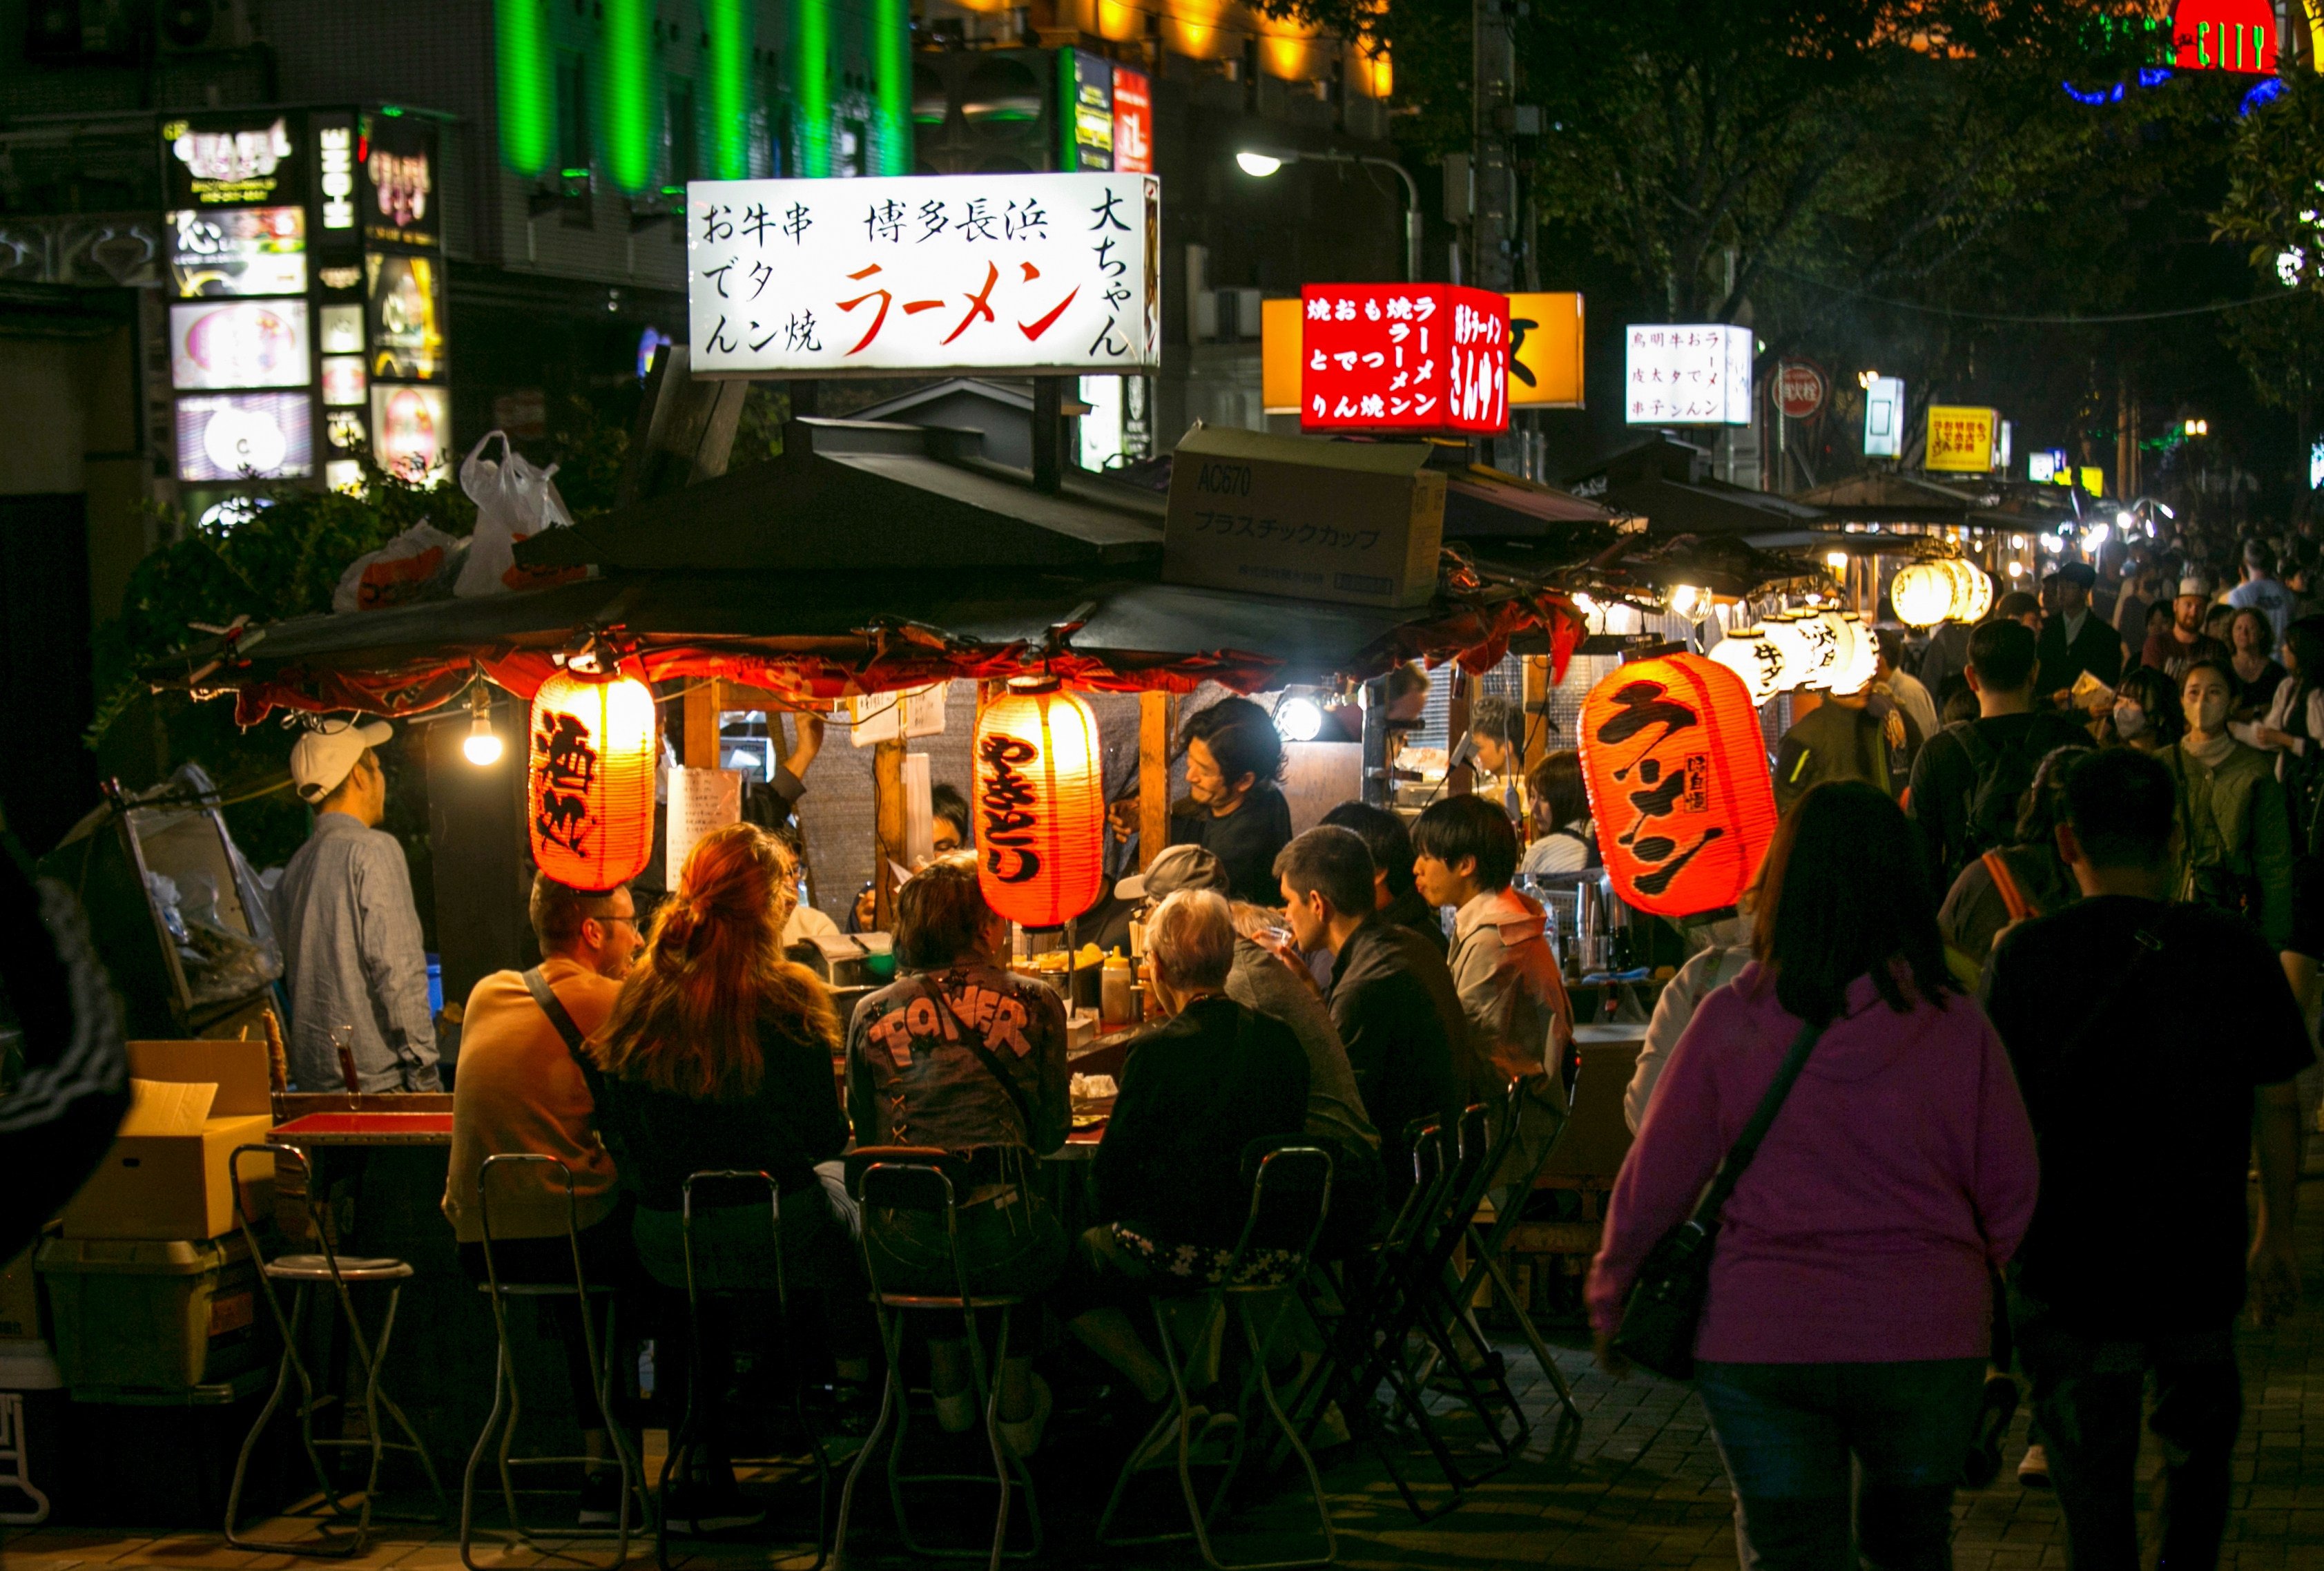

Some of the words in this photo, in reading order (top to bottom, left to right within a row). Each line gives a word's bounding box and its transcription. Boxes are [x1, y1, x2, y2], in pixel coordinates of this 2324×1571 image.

[2198, 21, 2264, 70] CITY
[702, 204, 738, 354] おでん
[742, 202, 778, 351] 牛タン
[782, 200, 822, 352] 串焼
[863, 197, 1049, 243] 博多長浜
[1088, 187, 1132, 358] 大ちゃん
[835, 260, 1081, 356] ラーメン
[1307, 298, 1332, 418] 焼とり
[1333, 298, 1359, 418] おでん
[1360, 298, 1385, 418] もつ焼
[1386, 296, 1413, 416] 焼ラーメン
[1412, 296, 1437, 415] ラーメン
[1650, 332, 1665, 416] 明太子
[1669, 333, 1684, 417] 牛タン
[1686, 332, 1701, 416] おでん
[1705, 331, 1719, 416] ラーメン
[1194, 510, 1382, 551] プラスチックカップ
[1197, 463, 1251, 497] AC670
[1597, 680, 1725, 896] ラーメン
